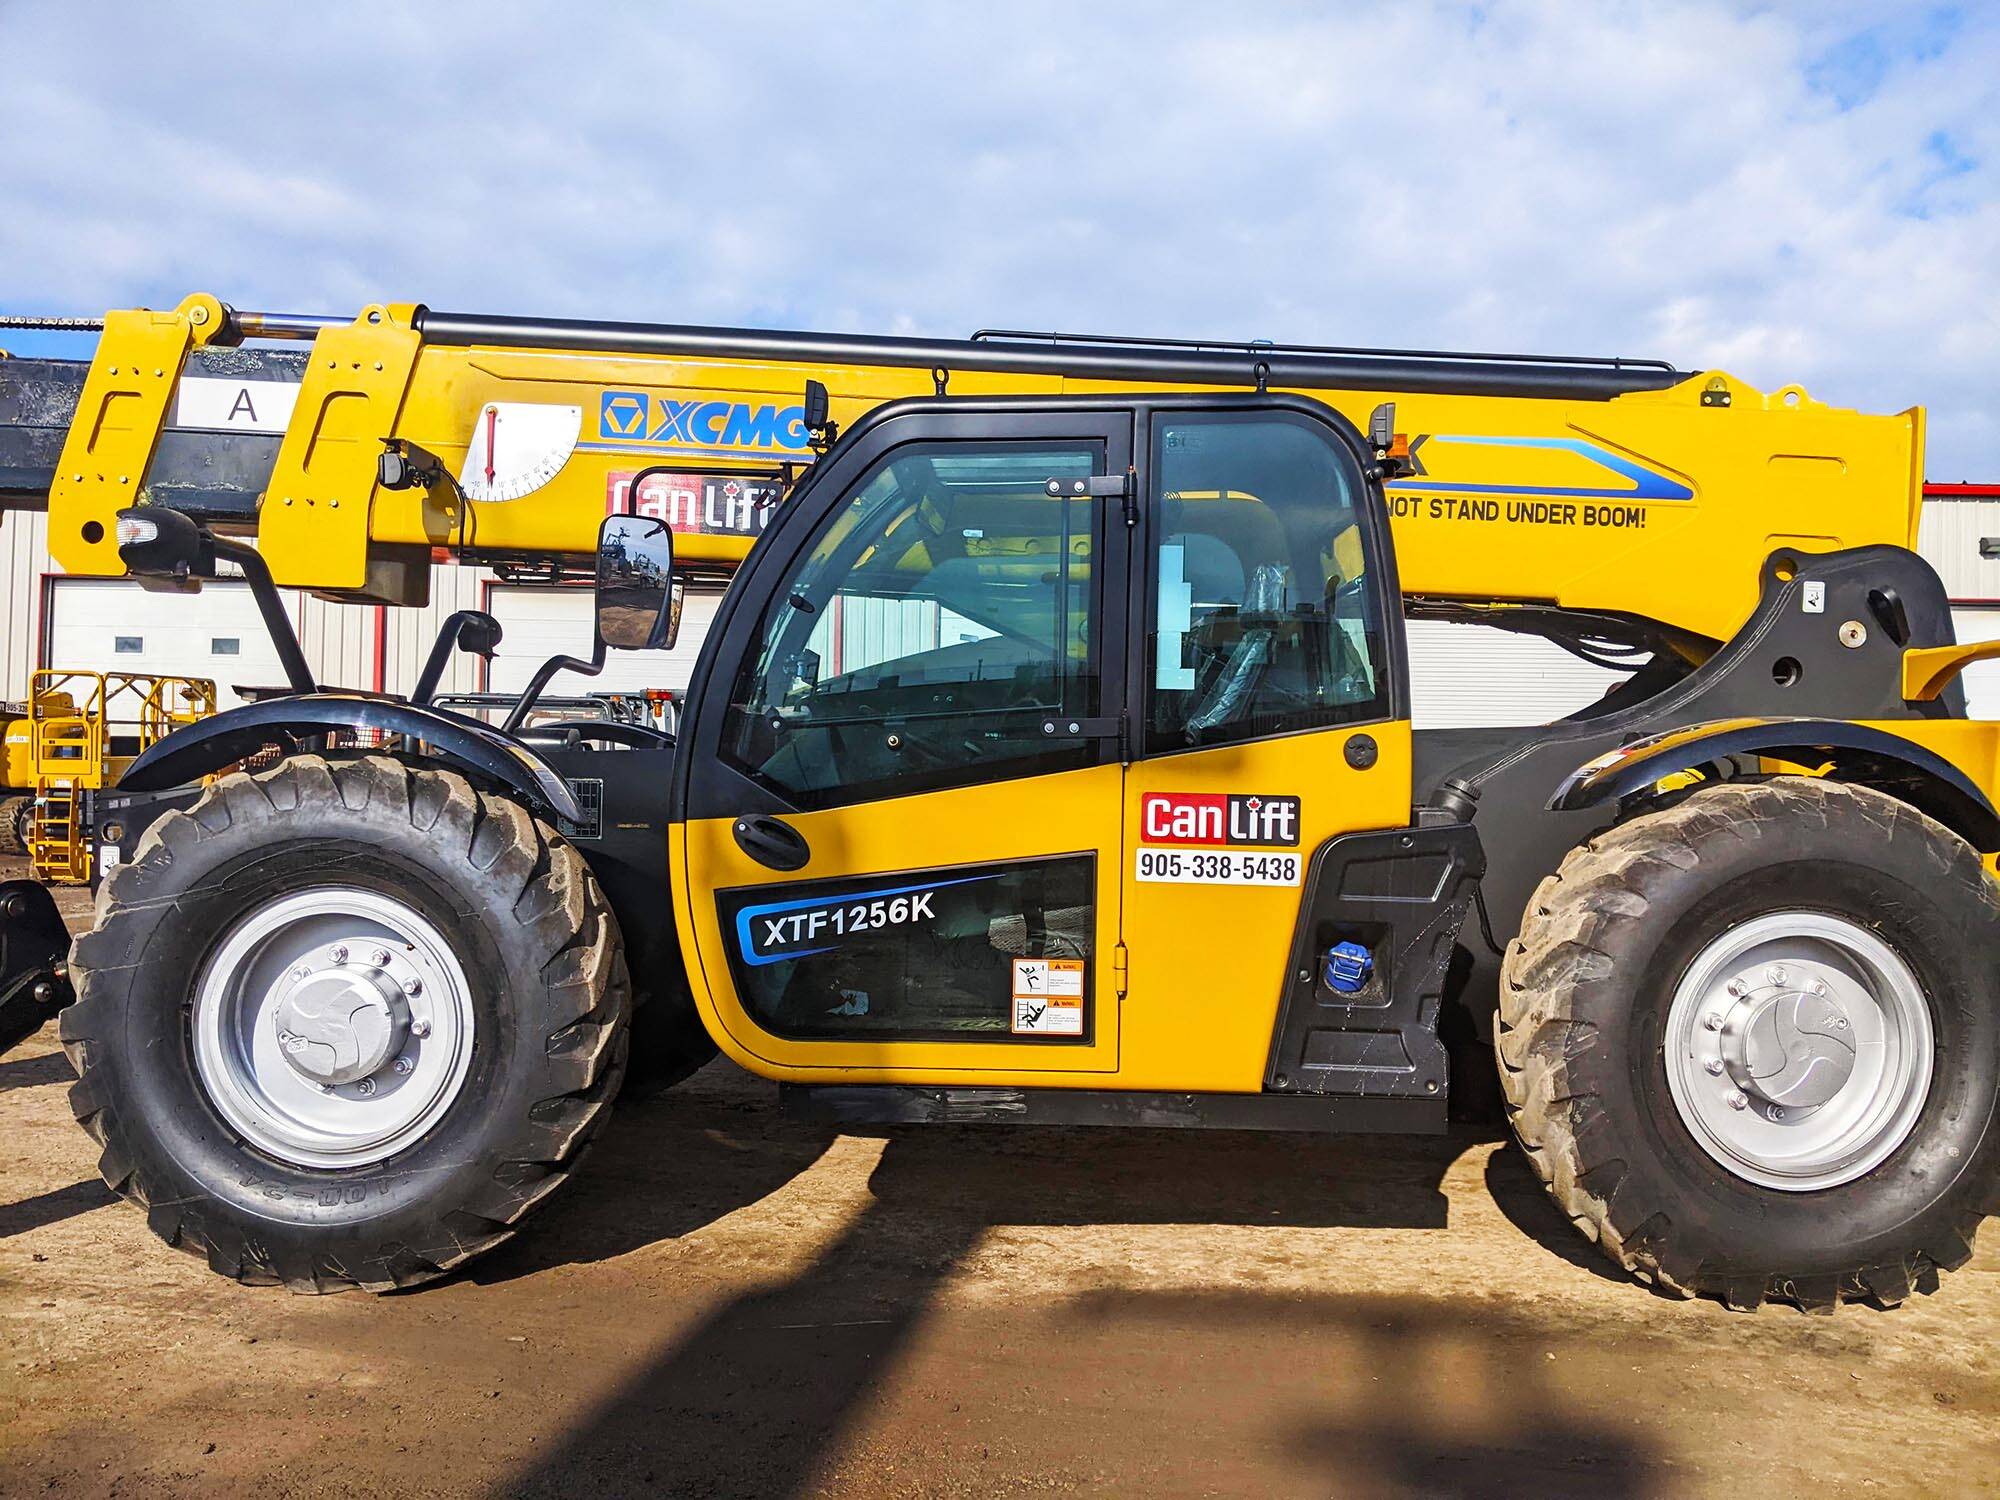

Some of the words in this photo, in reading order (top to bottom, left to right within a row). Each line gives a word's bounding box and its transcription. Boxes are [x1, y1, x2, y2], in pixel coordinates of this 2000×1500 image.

[228, 388, 258, 422] A
[647, 399, 811, 450] XCMG
[1429, 498, 1499, 521] STAND
[1506, 502, 1576, 525] UNDER
[1583, 507, 1646, 529] BOOM!
[1141, 853, 1296, 881] 905-338-5438
[763, 892, 936, 947] XTF1256K
